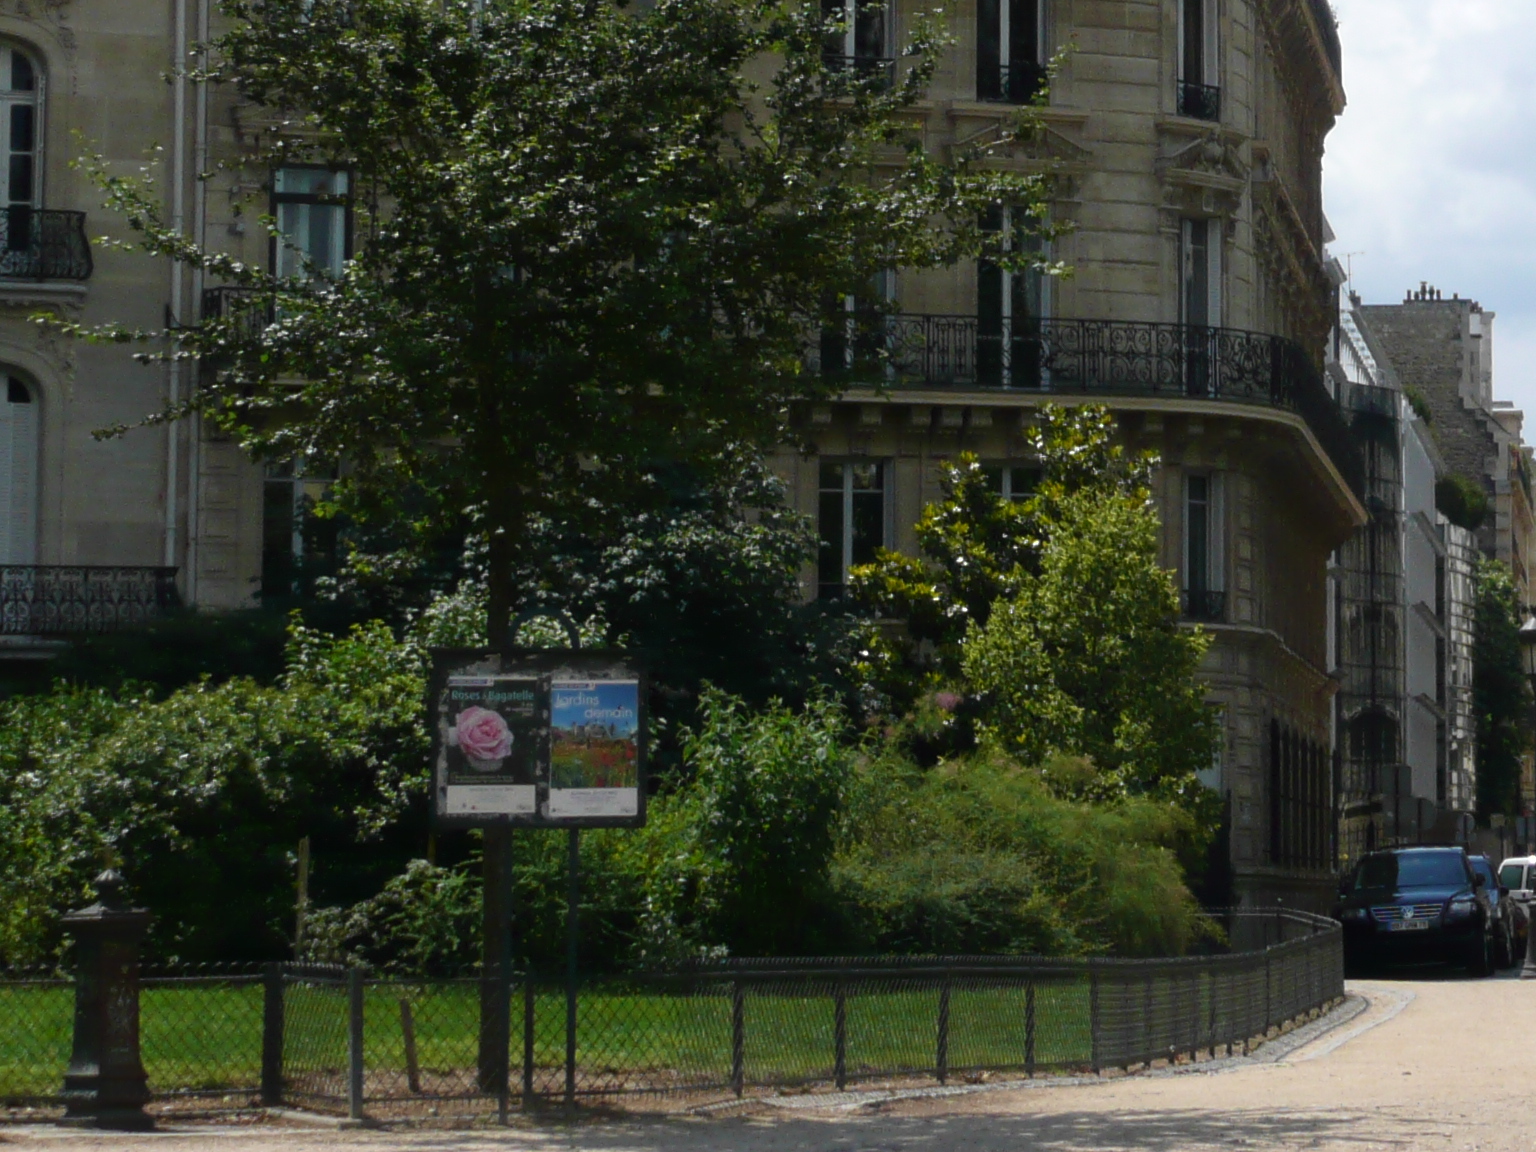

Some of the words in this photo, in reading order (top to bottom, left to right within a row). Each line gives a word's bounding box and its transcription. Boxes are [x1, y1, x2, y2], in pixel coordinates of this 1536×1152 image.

[452, 690, 480, 700] Roses
[488, 689, 534, 702] Bagatelle
[554, 692, 600, 707] Jardins
